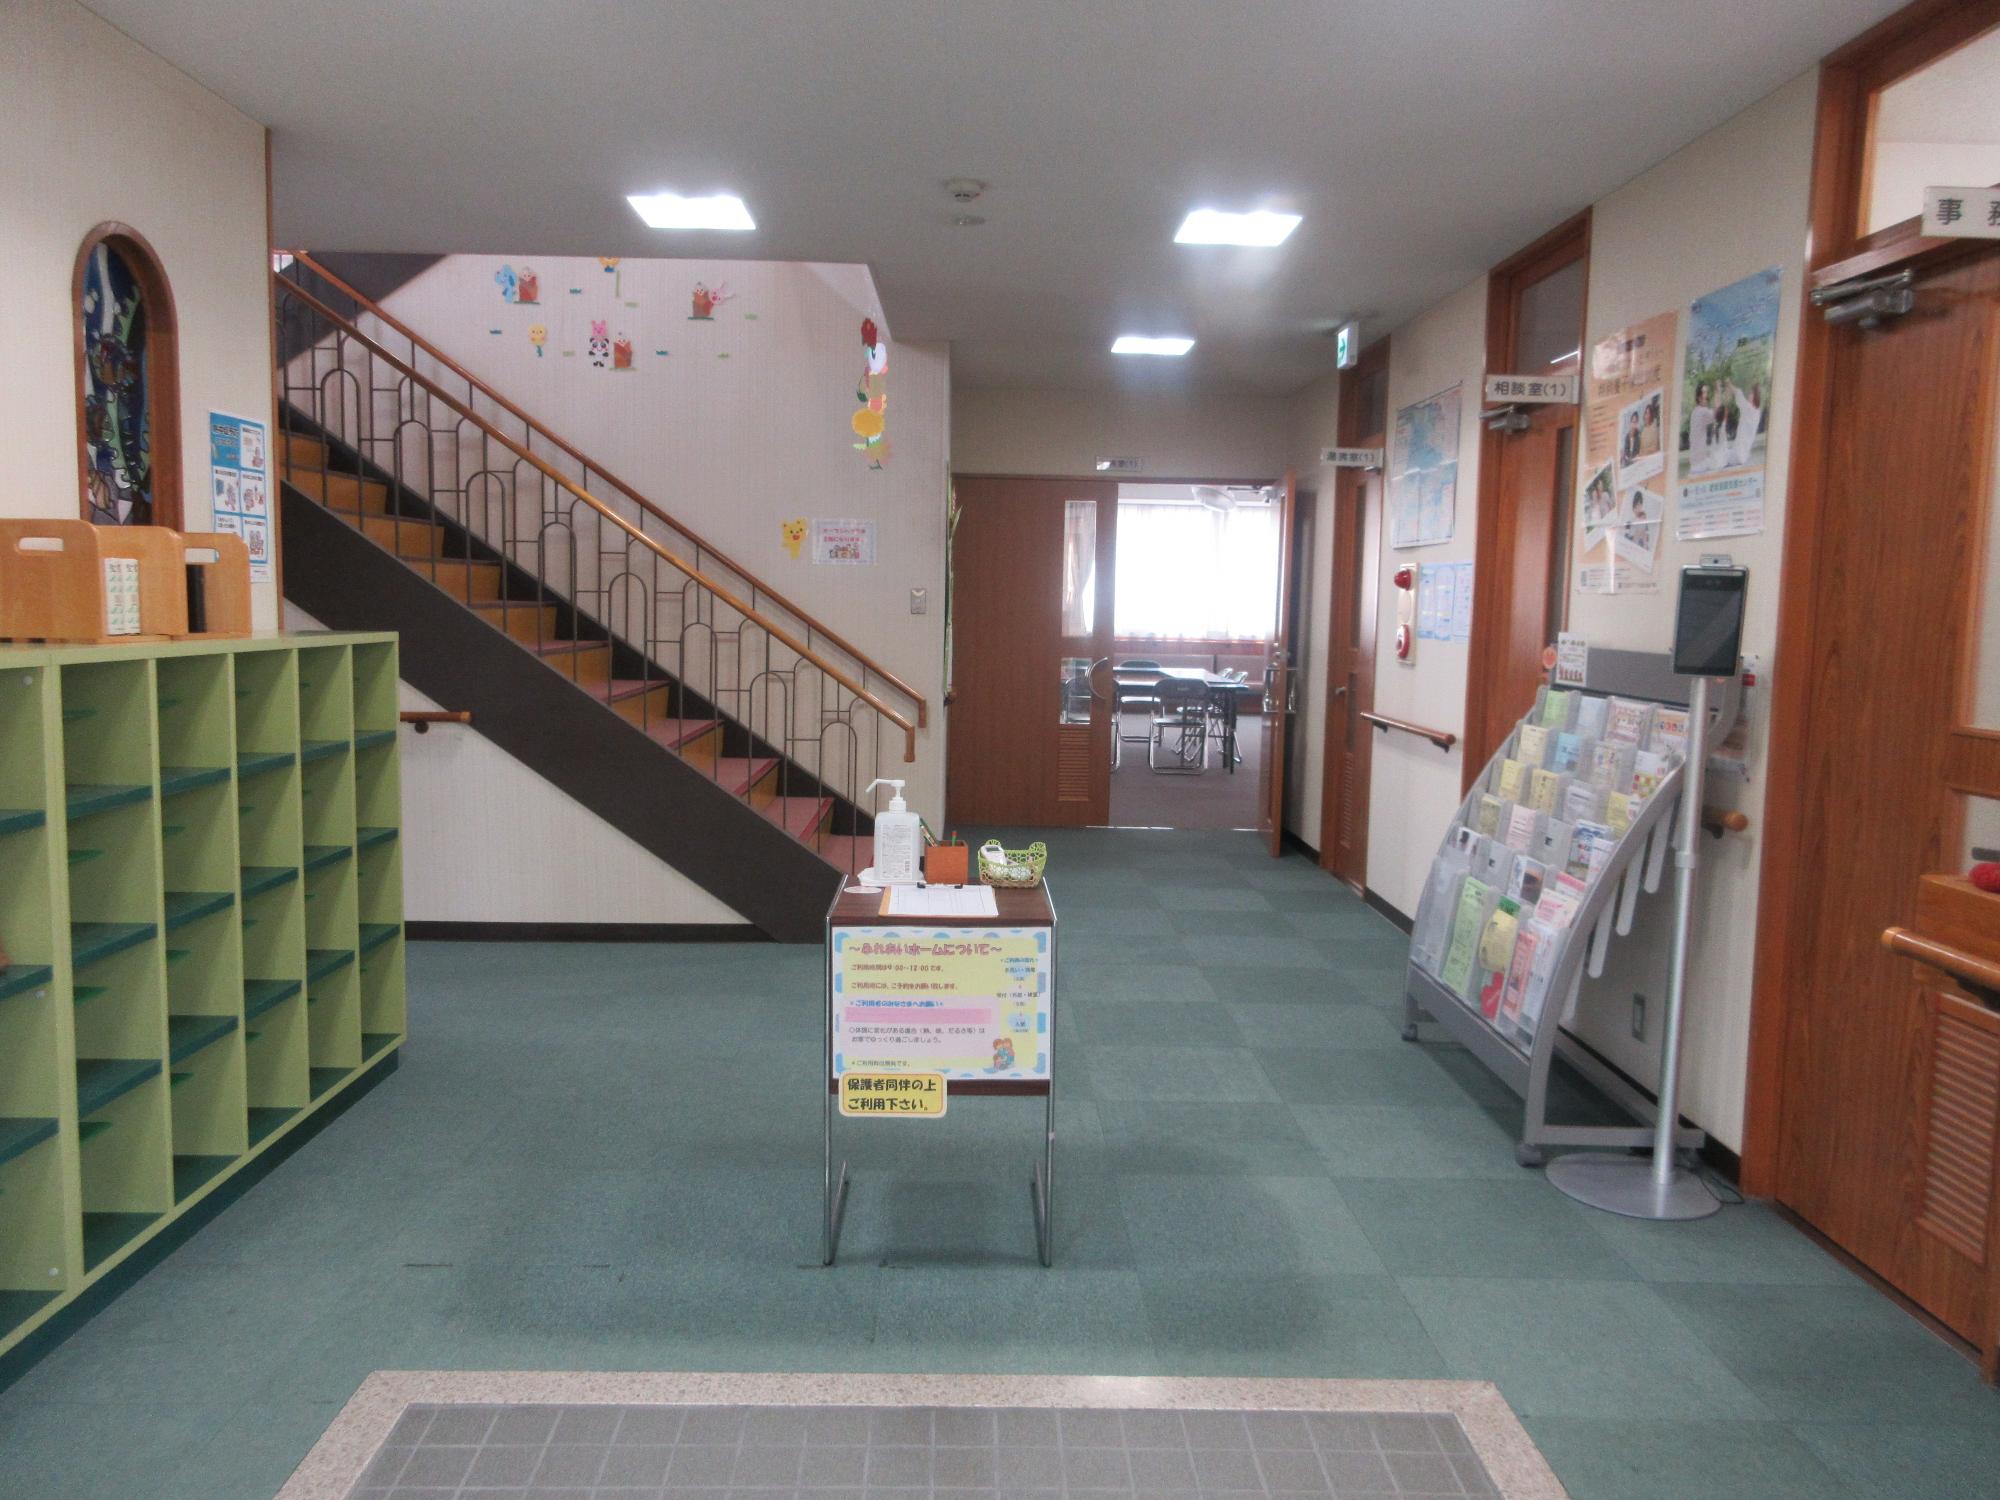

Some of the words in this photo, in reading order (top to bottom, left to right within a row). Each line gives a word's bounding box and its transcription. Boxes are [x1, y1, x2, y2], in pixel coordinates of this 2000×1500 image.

[1494, 380, 1566, 397] 相談室(1)
[847, 1078, 937, 1092] 保護者同伴の上
[847, 1097, 929, 1111] ご利用下さい。
